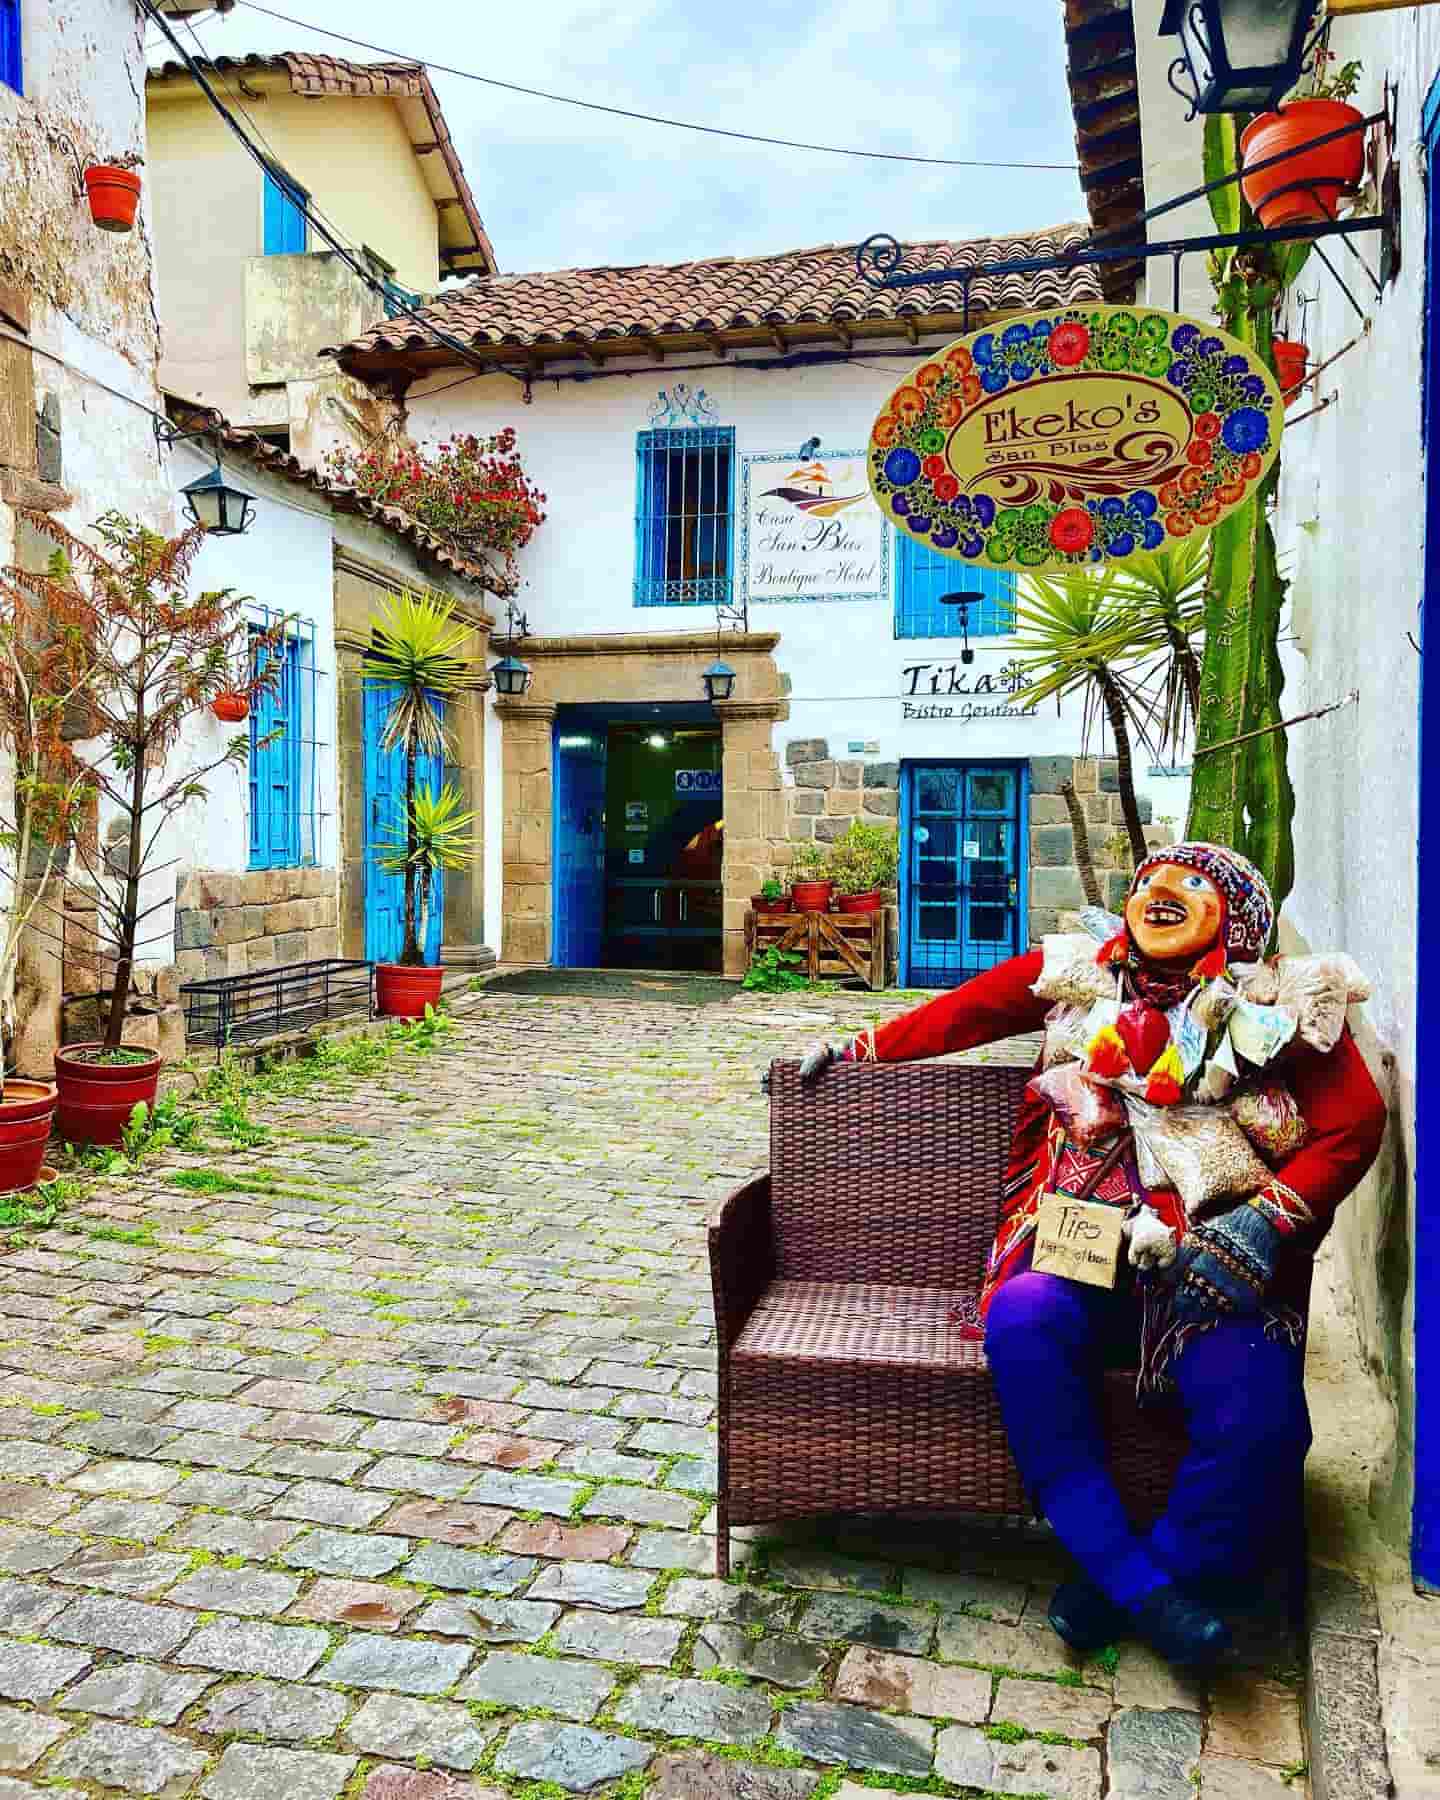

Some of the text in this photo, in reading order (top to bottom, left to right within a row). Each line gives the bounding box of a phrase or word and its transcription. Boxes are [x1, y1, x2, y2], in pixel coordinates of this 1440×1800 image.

[982, 393, 1161, 444] Ekeko's
[985, 439, 1108, 464] San Blas
[758, 520, 865, 551] San Blas
[753, 560, 878, 592] Boutique Hotel
[902, 664, 997, 695] Tika
[902, 702, 952, 719] Bistro
